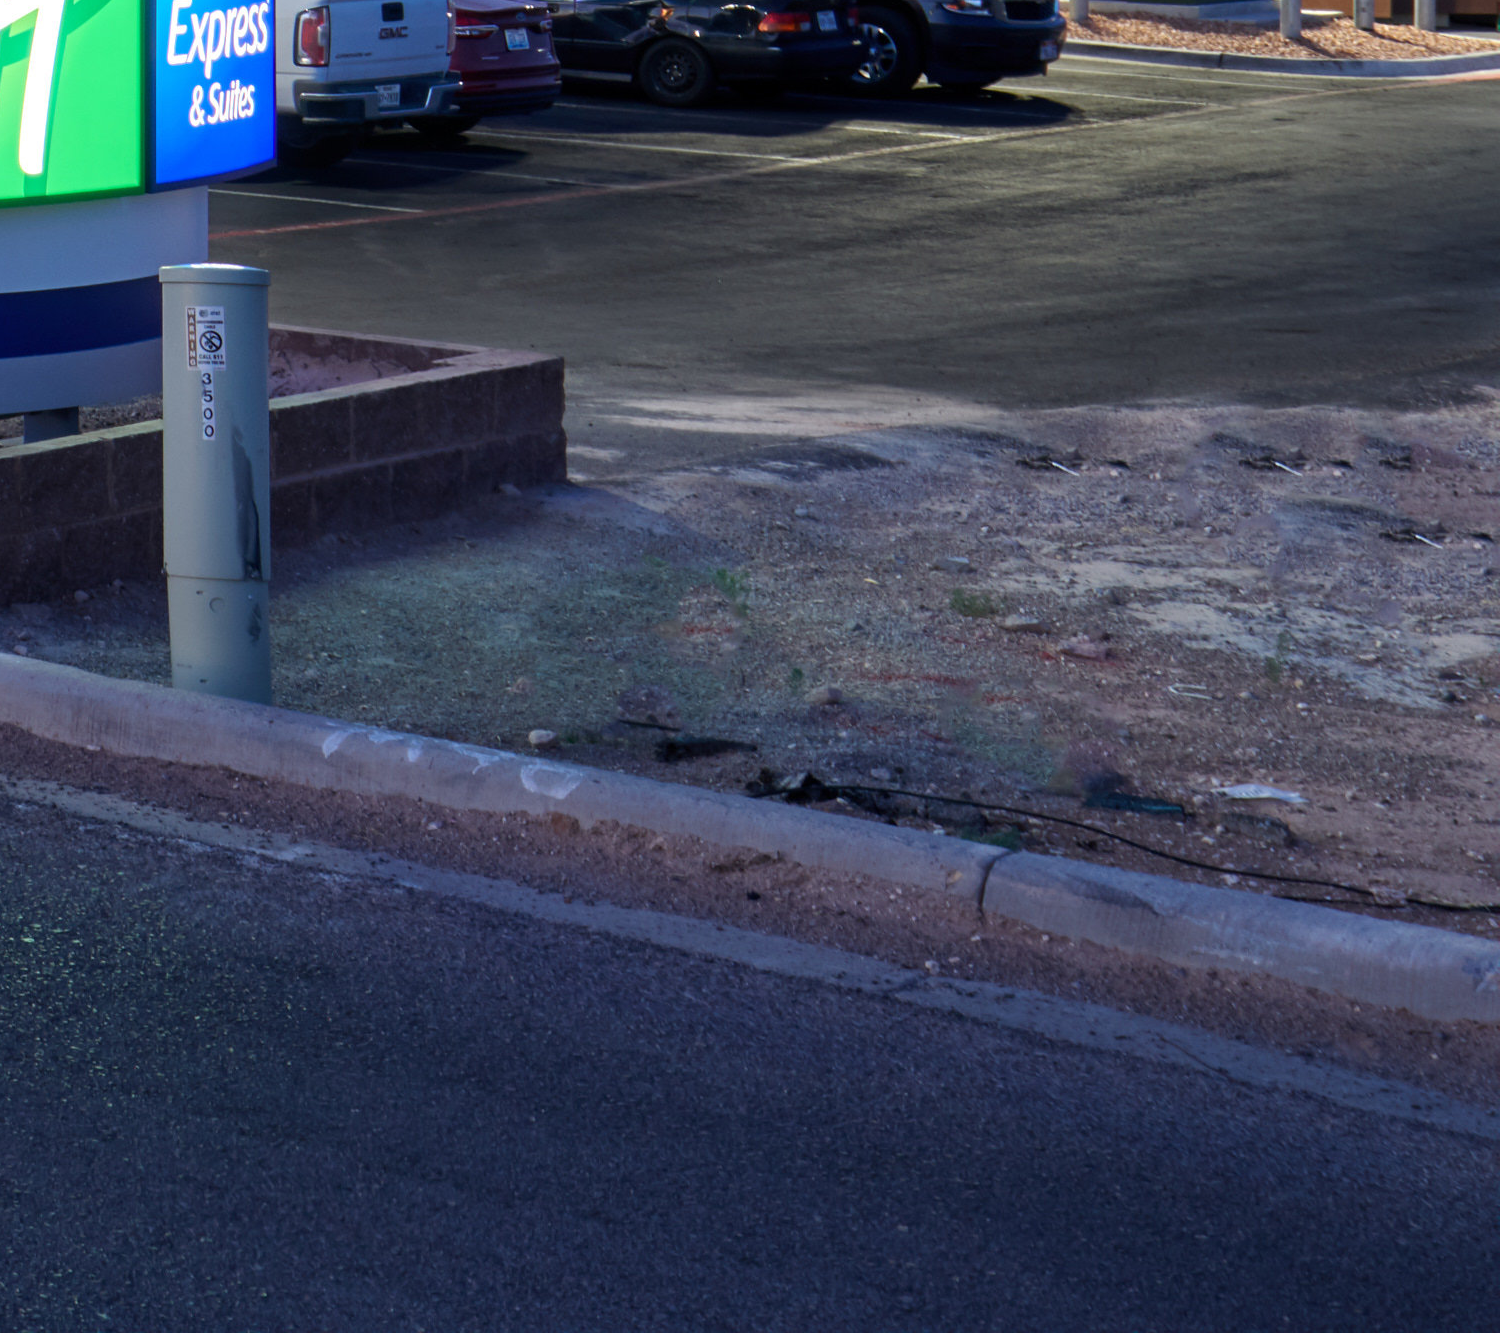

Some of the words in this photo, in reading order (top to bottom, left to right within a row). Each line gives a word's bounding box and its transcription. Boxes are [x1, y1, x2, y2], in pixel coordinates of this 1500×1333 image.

[378, 26, 408, 40] GMC
[189, 84, 205, 127] &
[206, 79, 255, 125] Suites
[188, 308, 197, 366] WARNING
[202, 372, 214, 438] 3500
